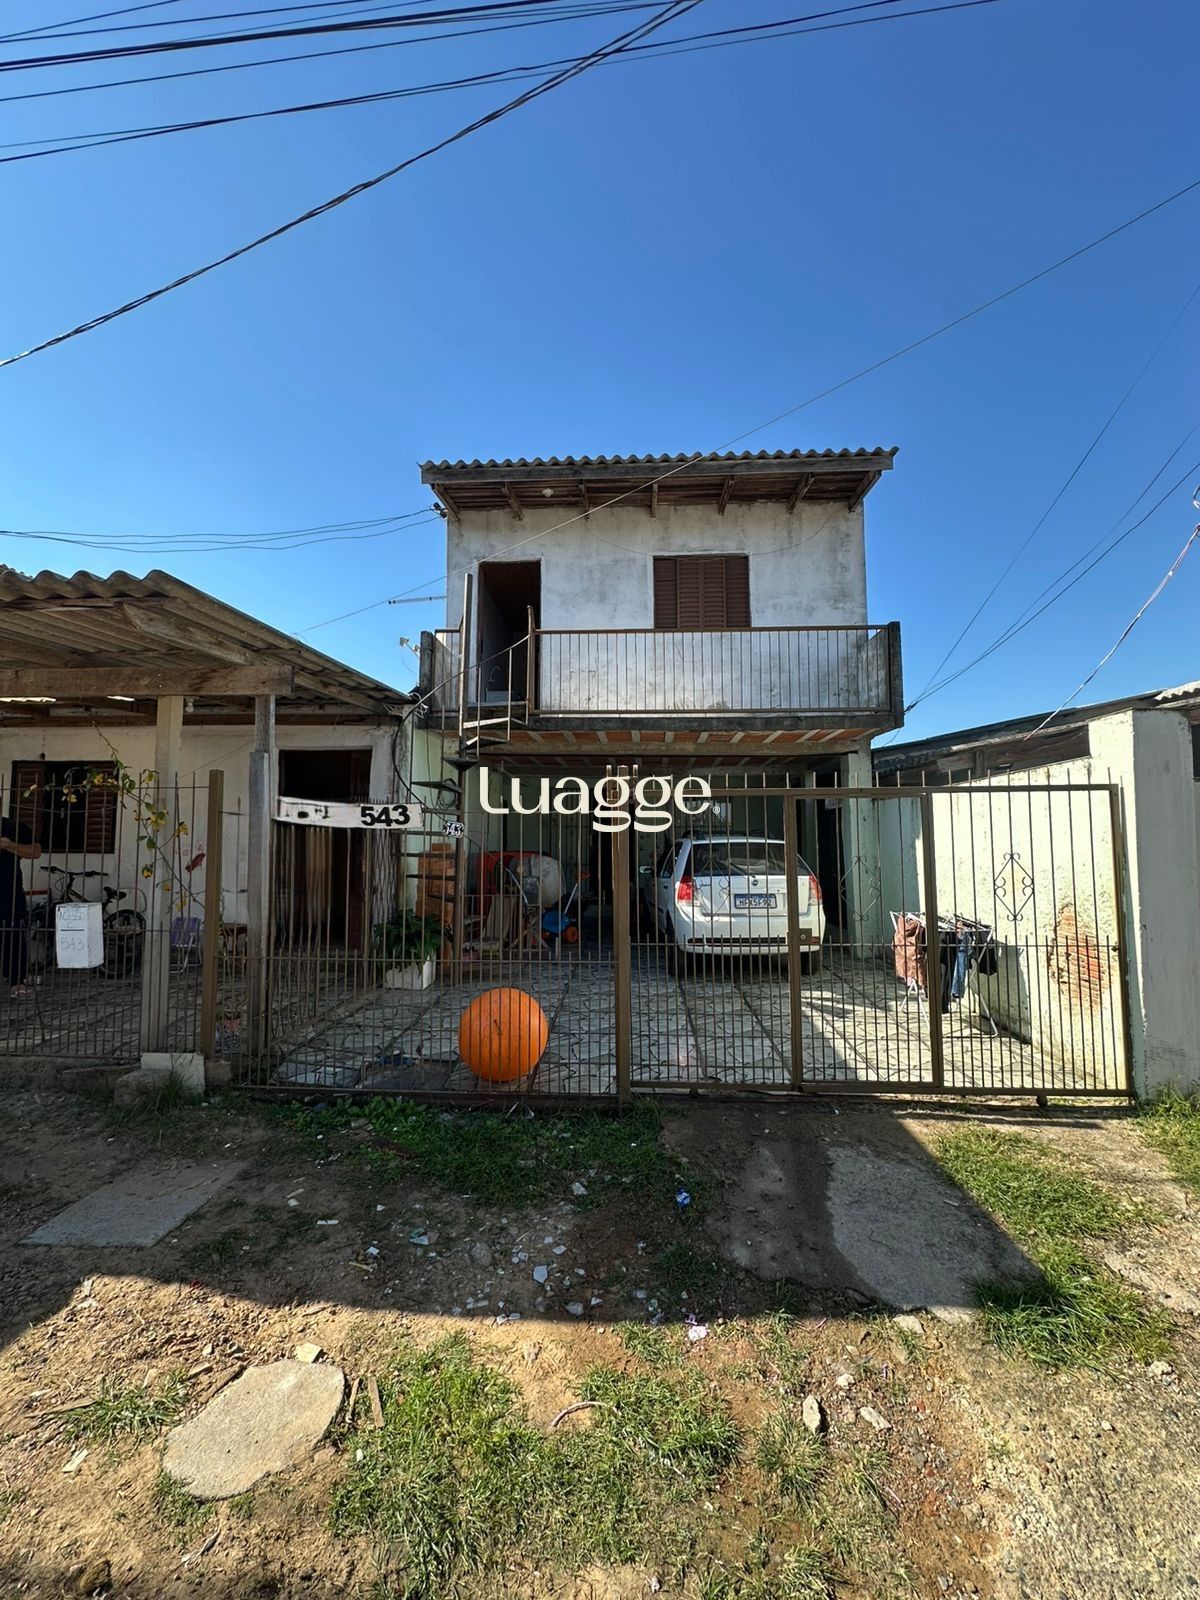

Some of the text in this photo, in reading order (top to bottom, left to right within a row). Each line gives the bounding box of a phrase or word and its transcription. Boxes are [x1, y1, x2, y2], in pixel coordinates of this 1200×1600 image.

[360, 804, 411, 827] 543
[442, 820, 462, 833] 543
[60, 936, 85, 951] 543
